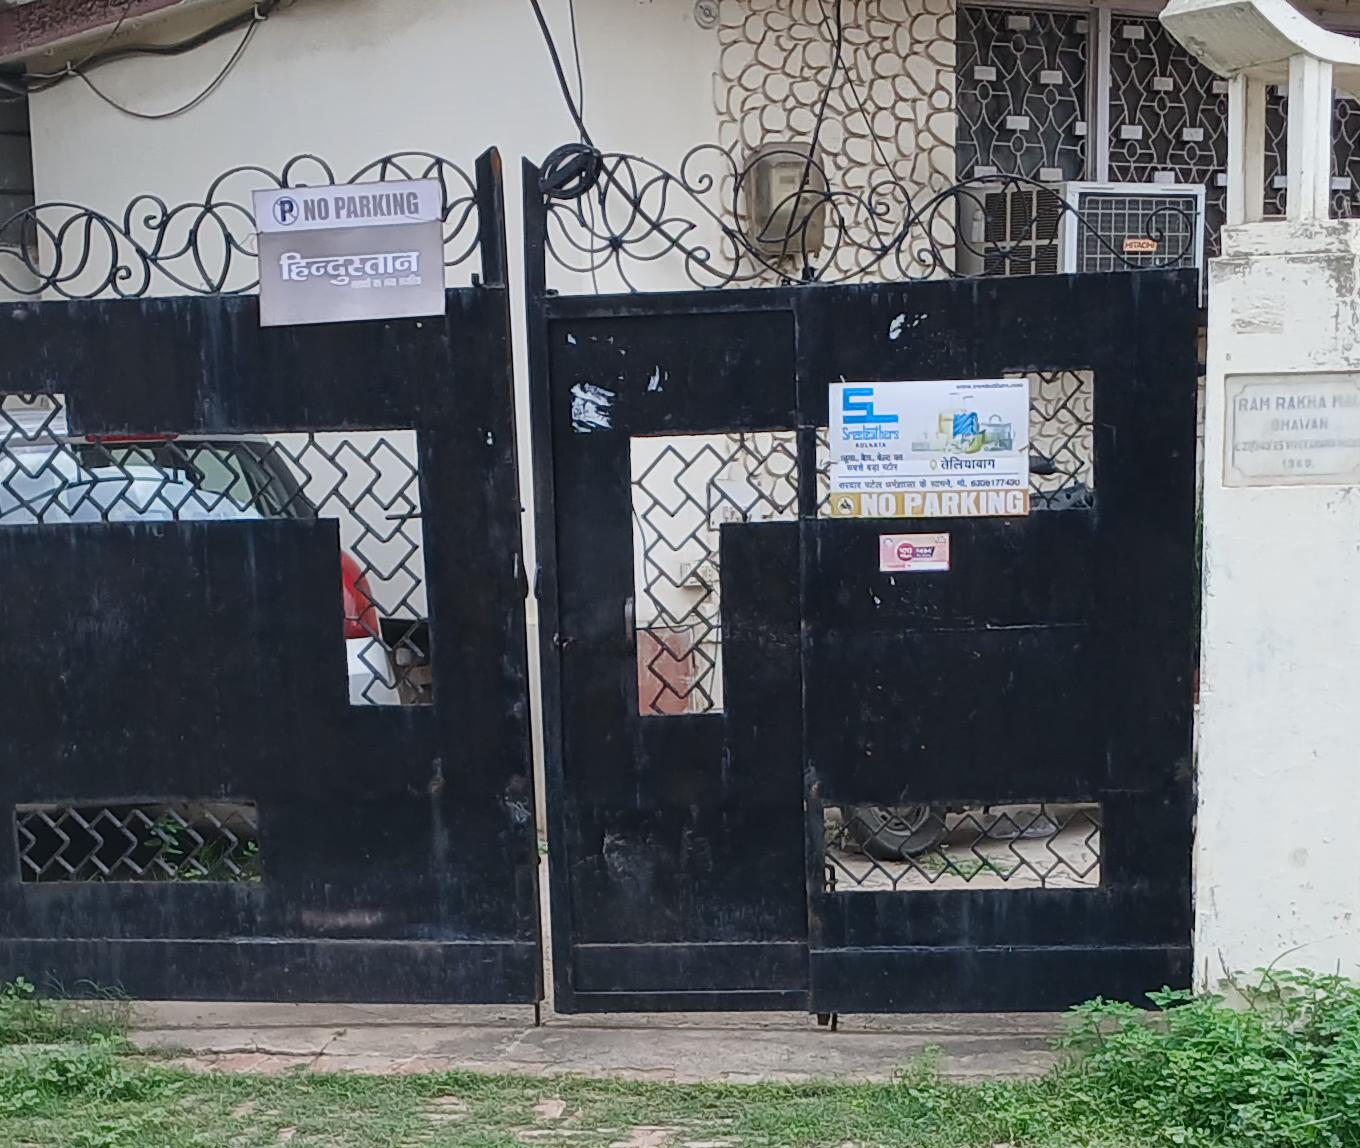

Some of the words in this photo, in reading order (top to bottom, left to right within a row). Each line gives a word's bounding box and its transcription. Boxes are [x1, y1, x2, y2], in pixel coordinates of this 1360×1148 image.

[303, 199, 330, 222] NO
[334, 191, 419, 220] PARKING
[279, 251, 420, 286] हिन्दुस्तान
[1238, 397, 1271, 412] RAM
[1275, 396, 1328, 411] RAKHA
[941, 456, 995, 470] तेलियाबाग
[861, 493, 897, 516] NO
[904, 490, 1024, 516] PARKING
